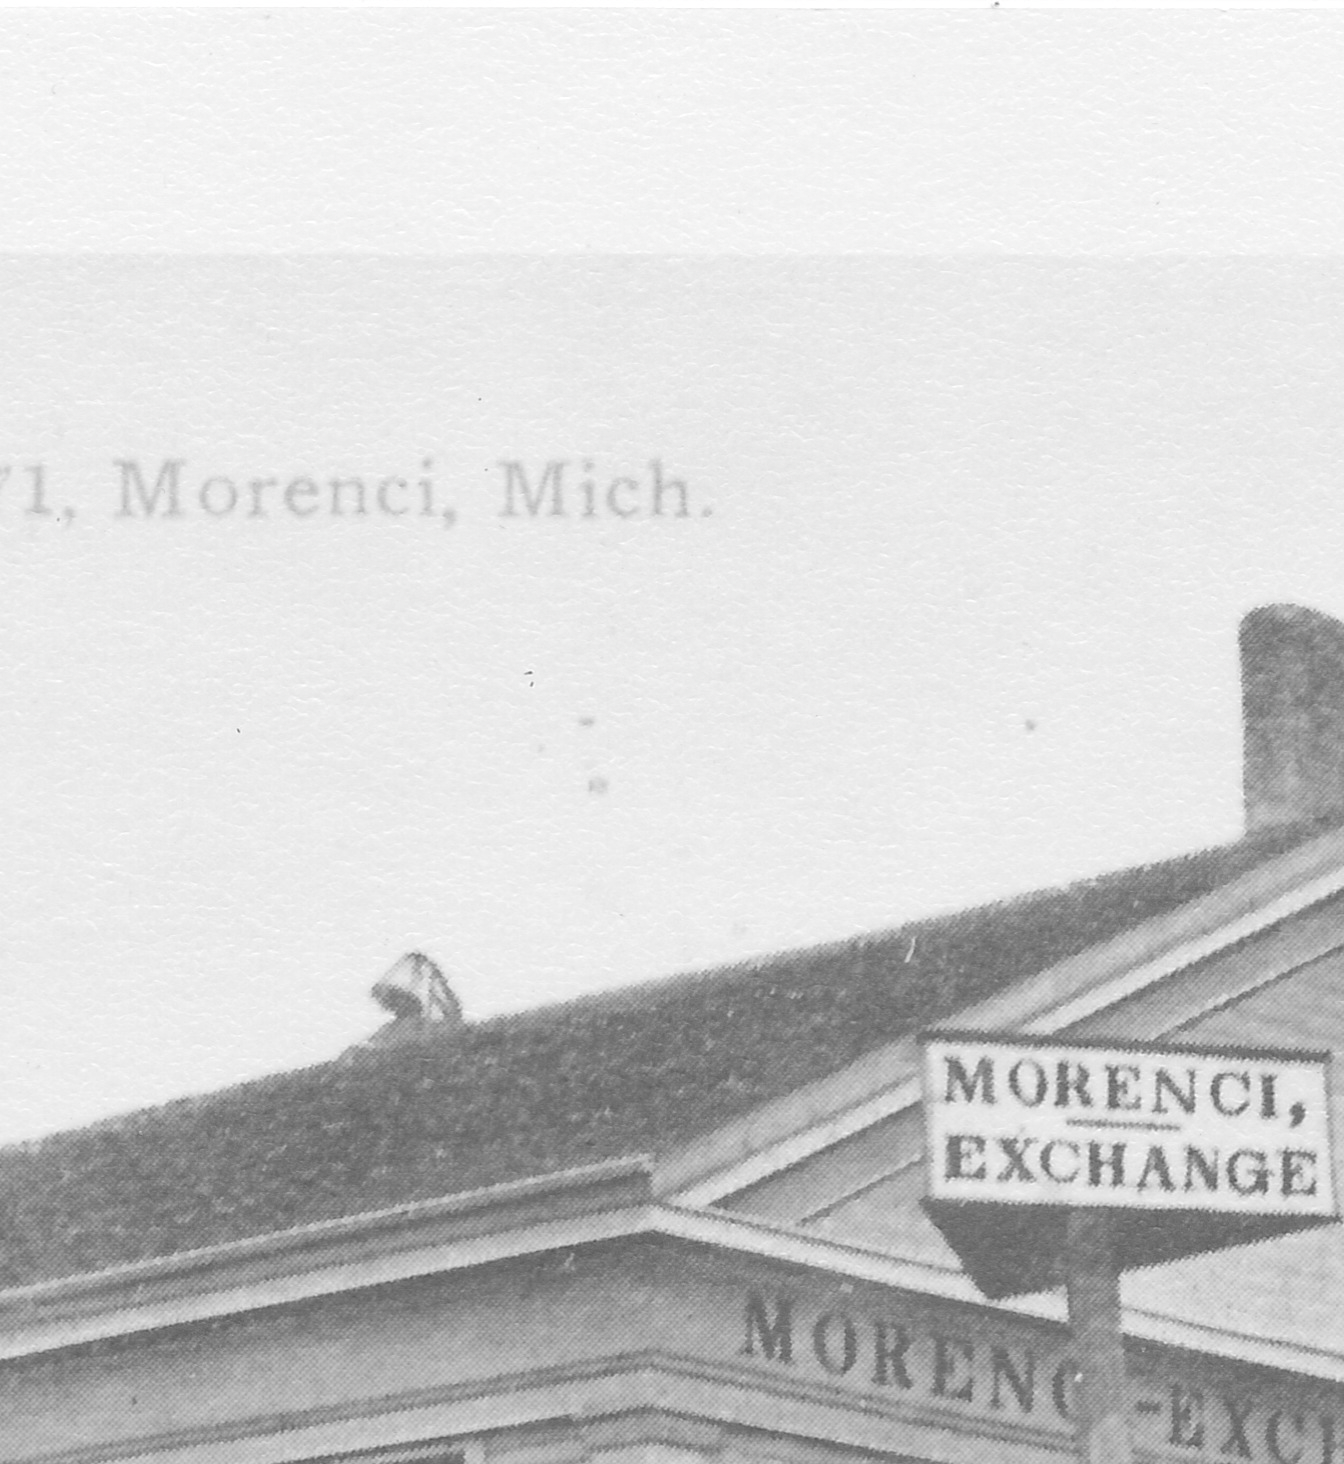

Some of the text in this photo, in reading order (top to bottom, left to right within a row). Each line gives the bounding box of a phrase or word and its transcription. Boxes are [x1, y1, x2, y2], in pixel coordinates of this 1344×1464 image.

[943, 1054, 1308, 1129] MORENCI,
[943, 1133, 1319, 1197] EXCHANGE
[740, 1292, 1080, 1420] MORENC
